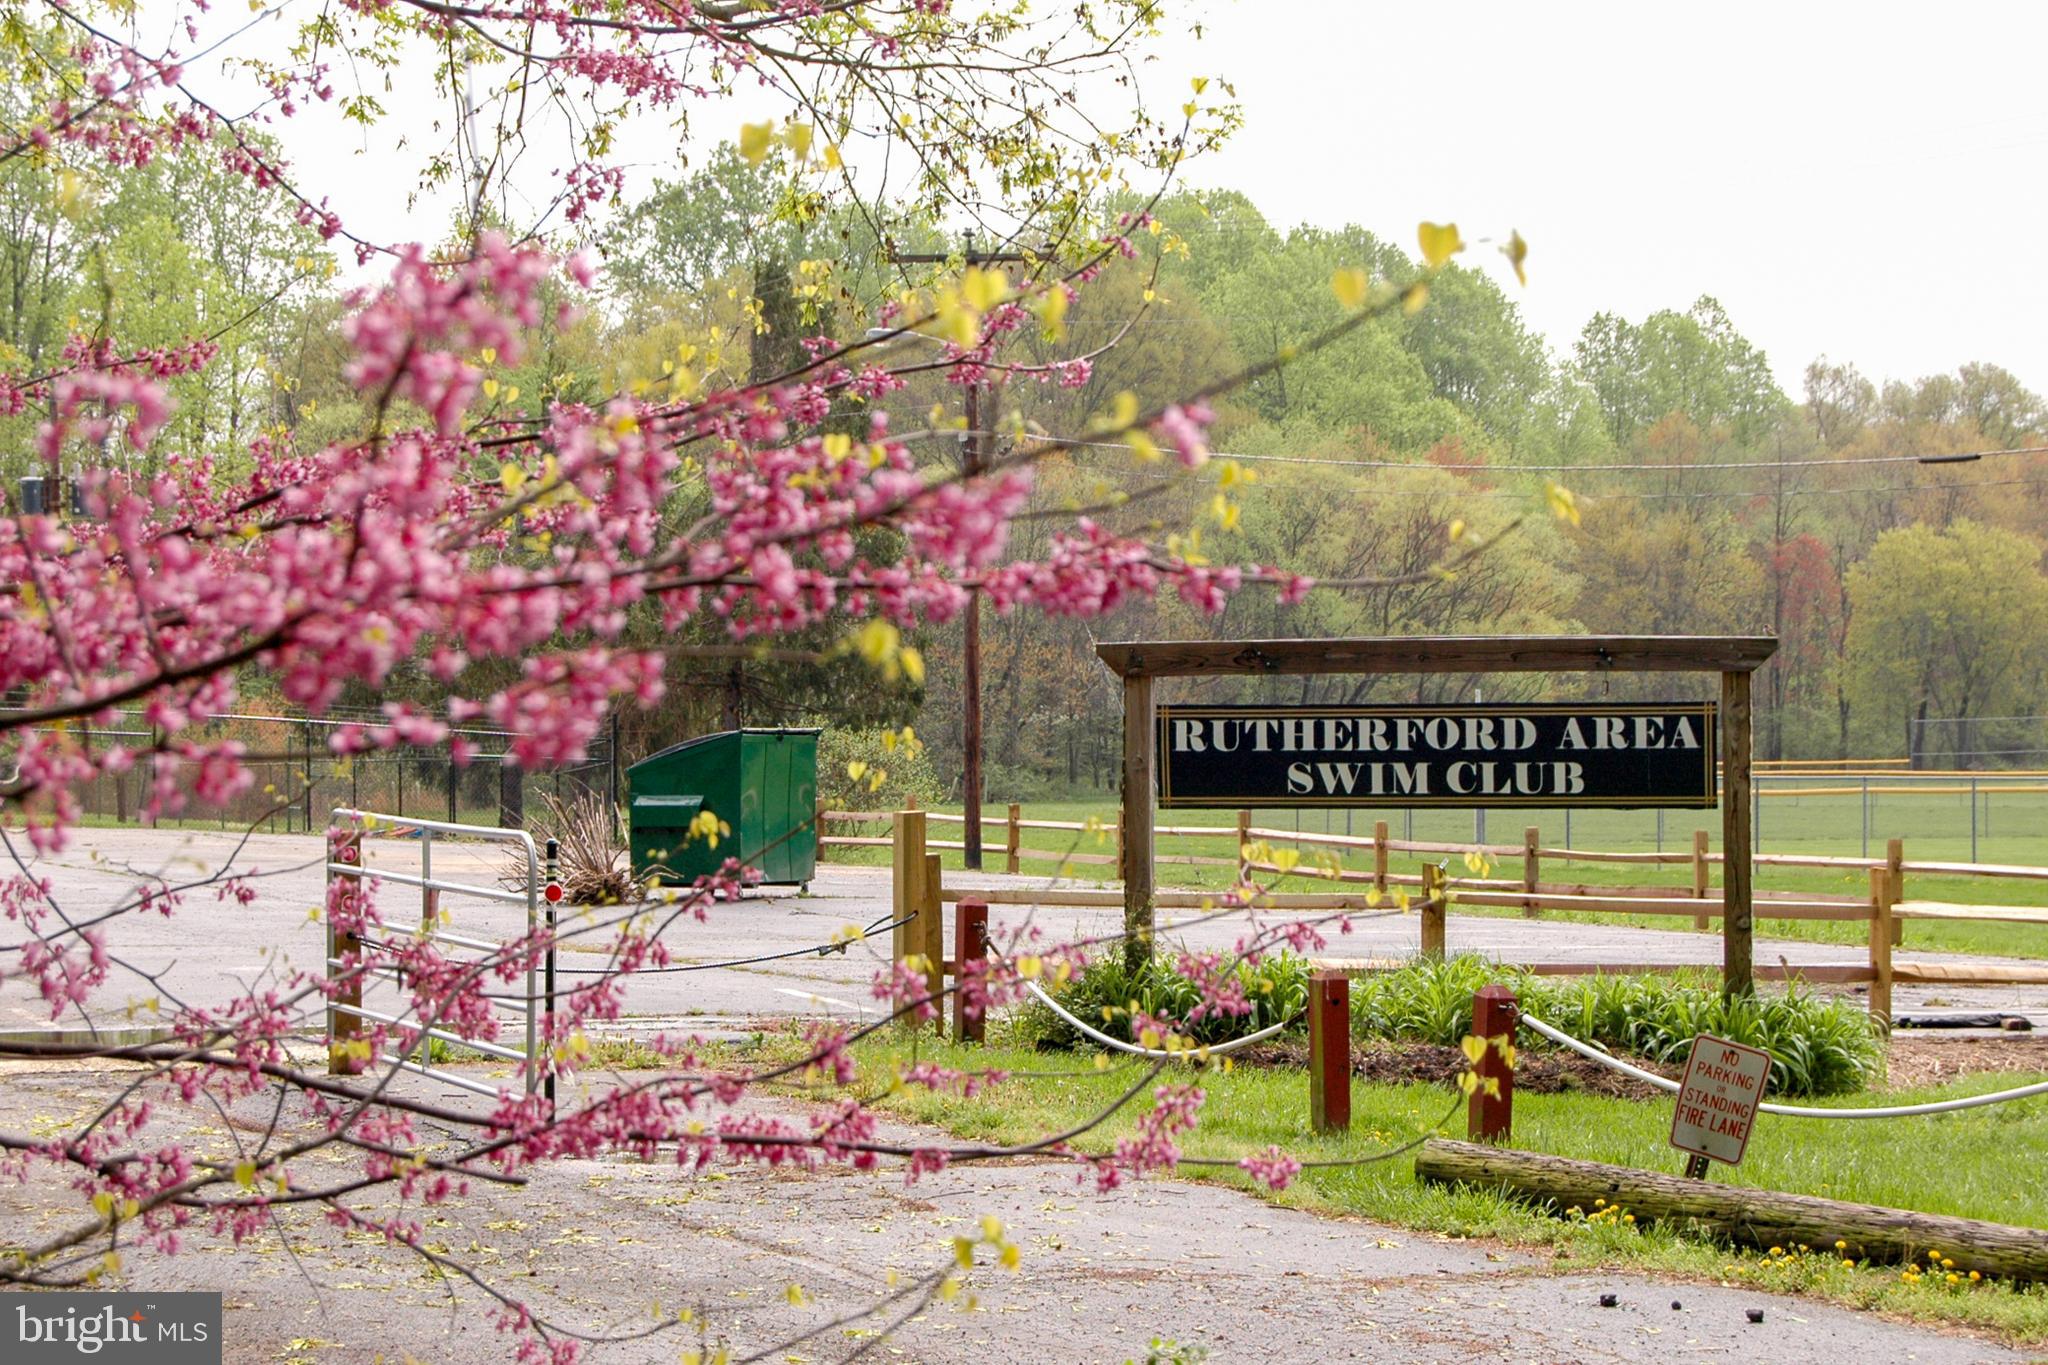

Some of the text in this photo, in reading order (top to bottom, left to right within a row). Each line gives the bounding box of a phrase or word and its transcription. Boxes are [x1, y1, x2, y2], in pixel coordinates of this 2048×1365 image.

[1172, 716, 1701, 752] RUTHERFORD AREA
[1286, 761, 1585, 795] SWIM CLUB
[1719, 1049, 1740, 1067] NO
[1696, 1061, 1754, 1091] PARKING
[1716, 1085, 1727, 1094] OR
[1684, 1087, 1750, 1119] STANDING
[1678, 1104, 1747, 1141] FIRE LANE
